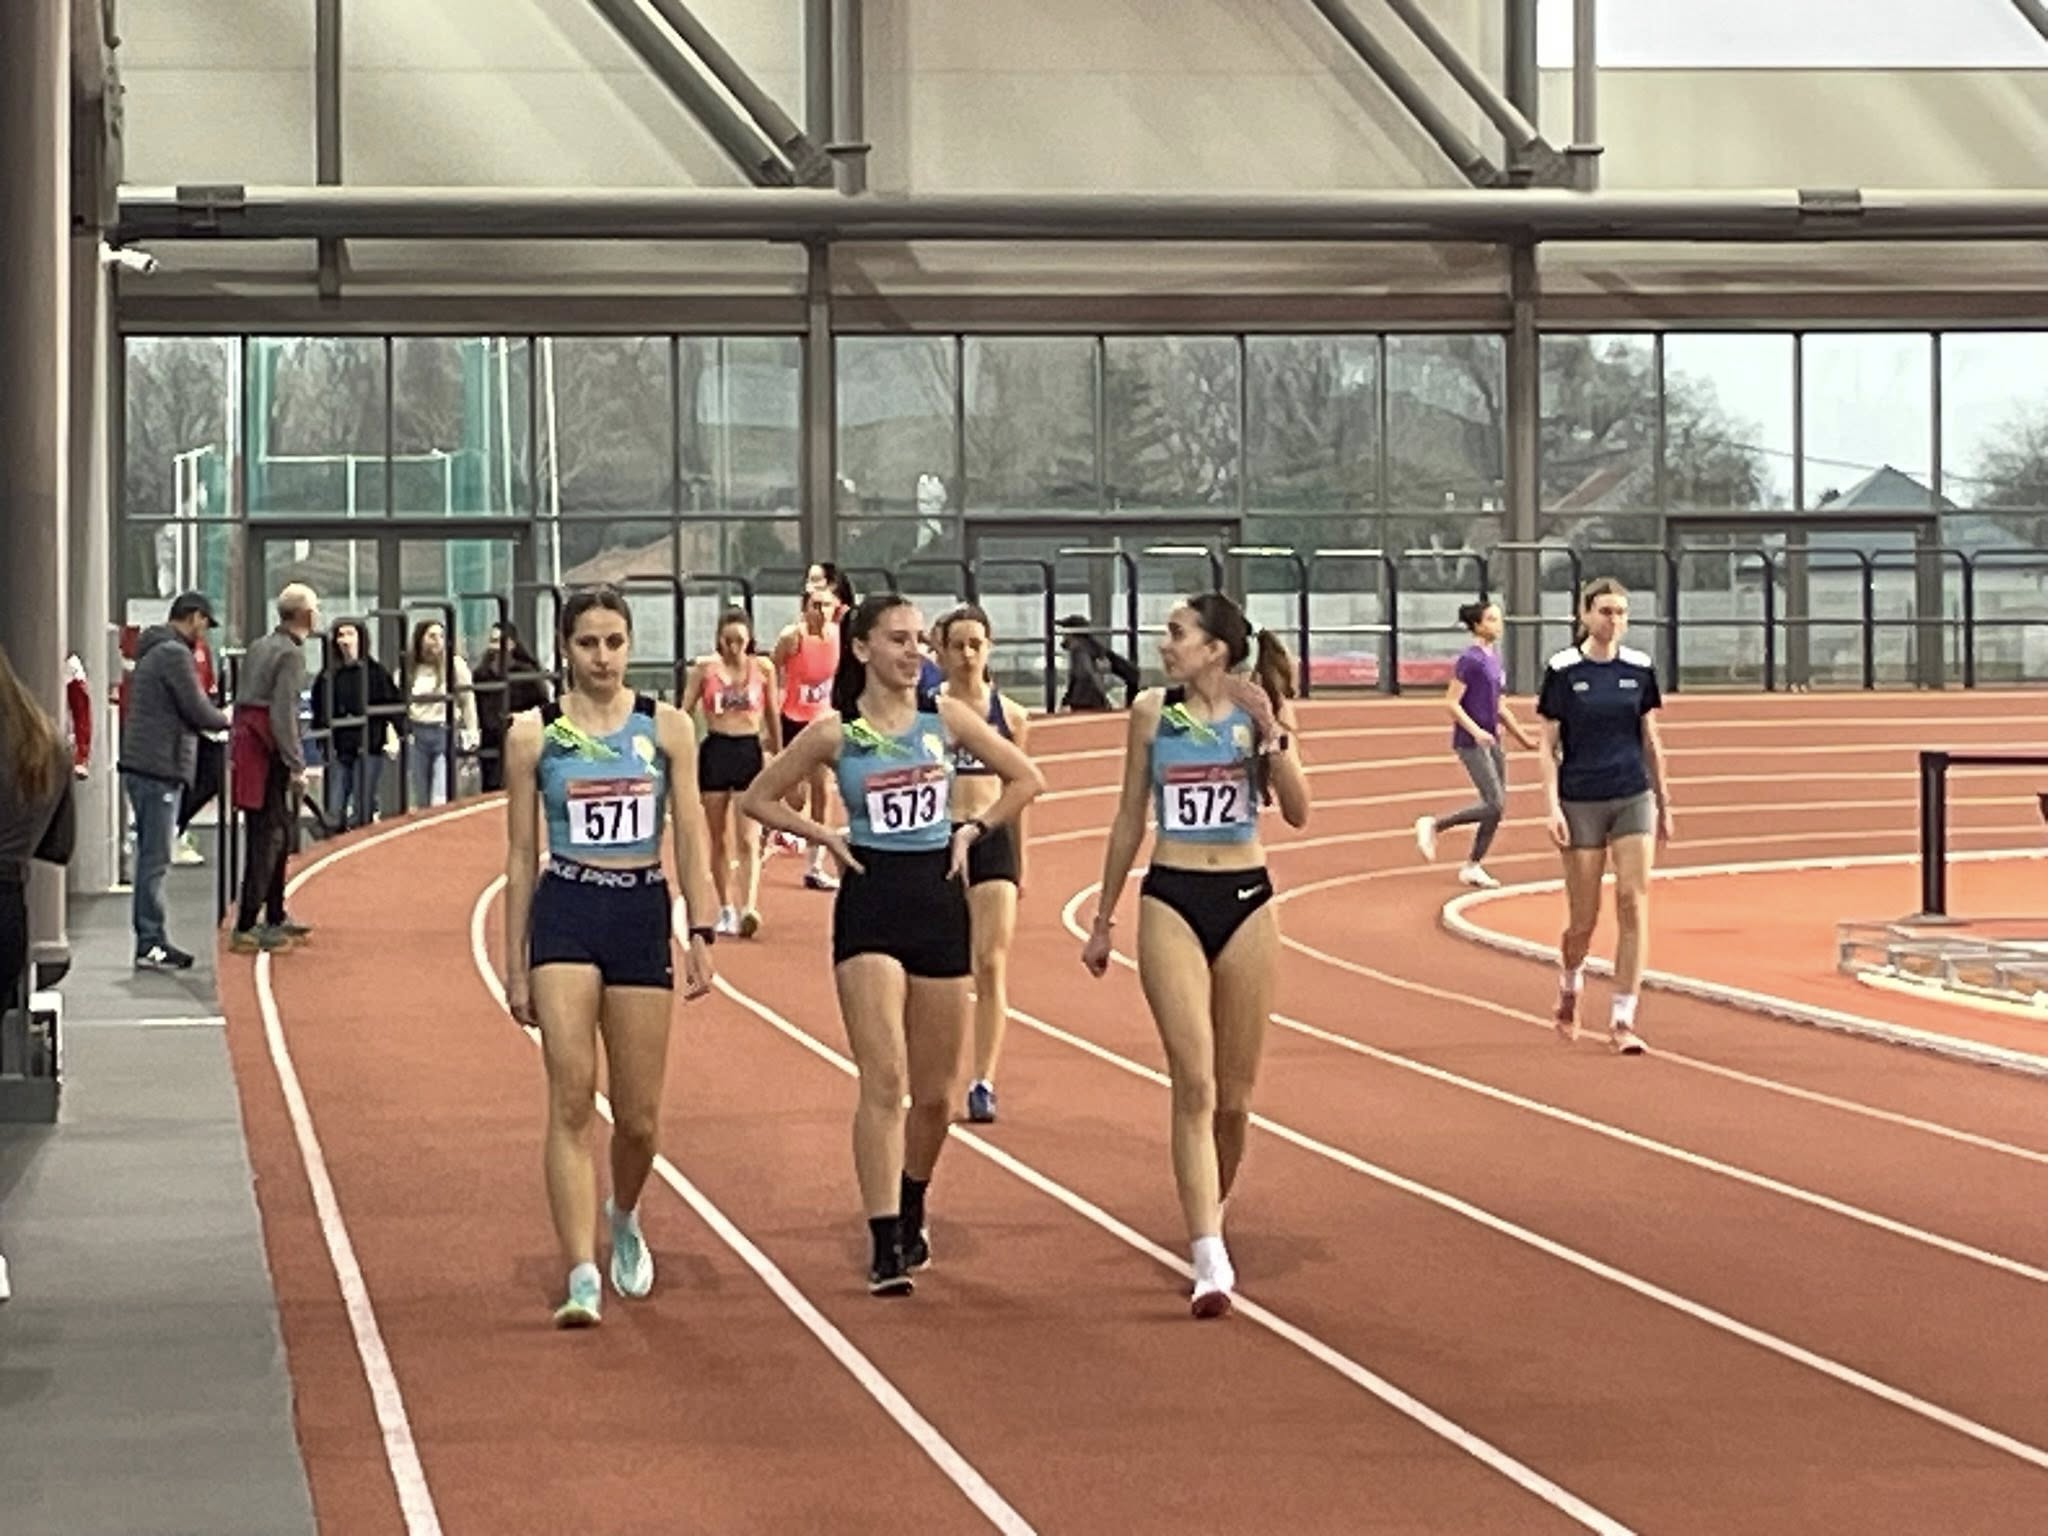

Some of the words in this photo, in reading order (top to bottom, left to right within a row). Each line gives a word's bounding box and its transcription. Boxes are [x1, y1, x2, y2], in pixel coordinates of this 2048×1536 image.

[584, 798, 639, 841] 571
[882, 785, 937, 829] 573
[1178, 785, 1237, 826] 572
[580, 868, 638, 888] PRO
